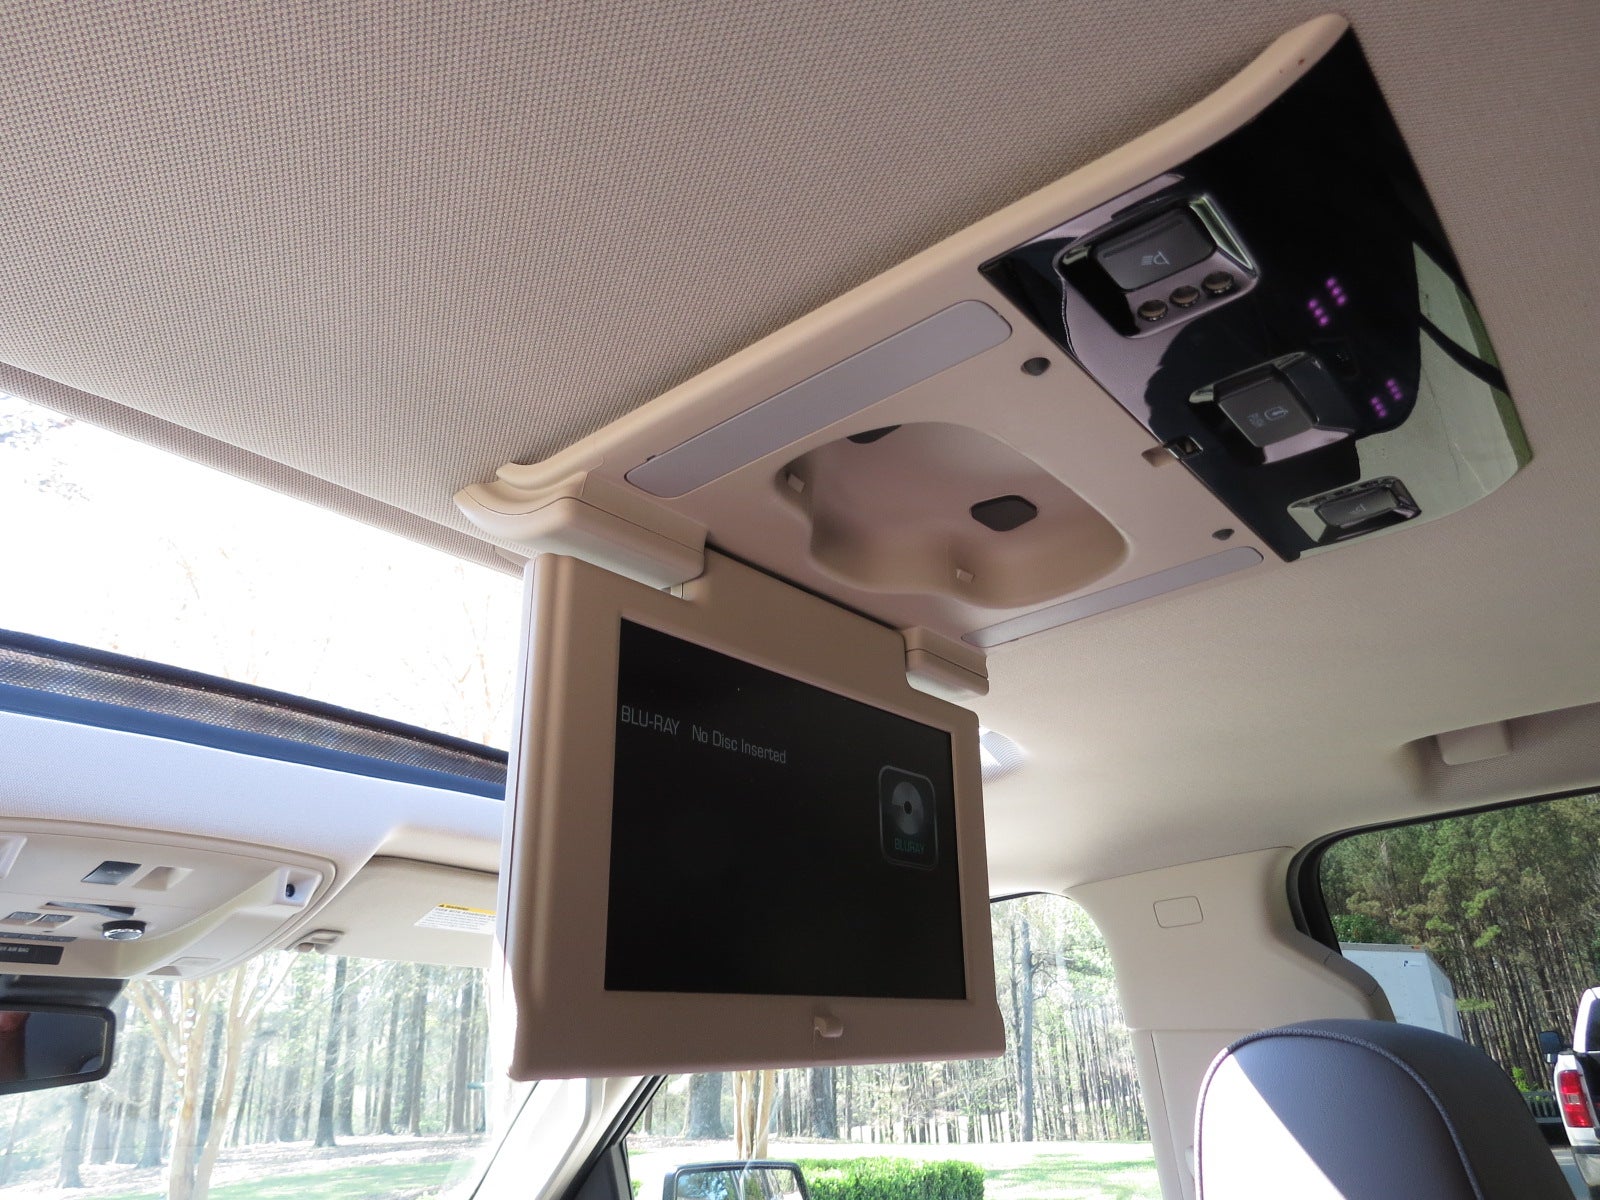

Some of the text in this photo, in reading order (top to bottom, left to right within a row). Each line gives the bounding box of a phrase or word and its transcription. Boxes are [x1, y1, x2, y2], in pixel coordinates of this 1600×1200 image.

[621, 705, 786, 764] BLU-RAY No Disc Inserted
